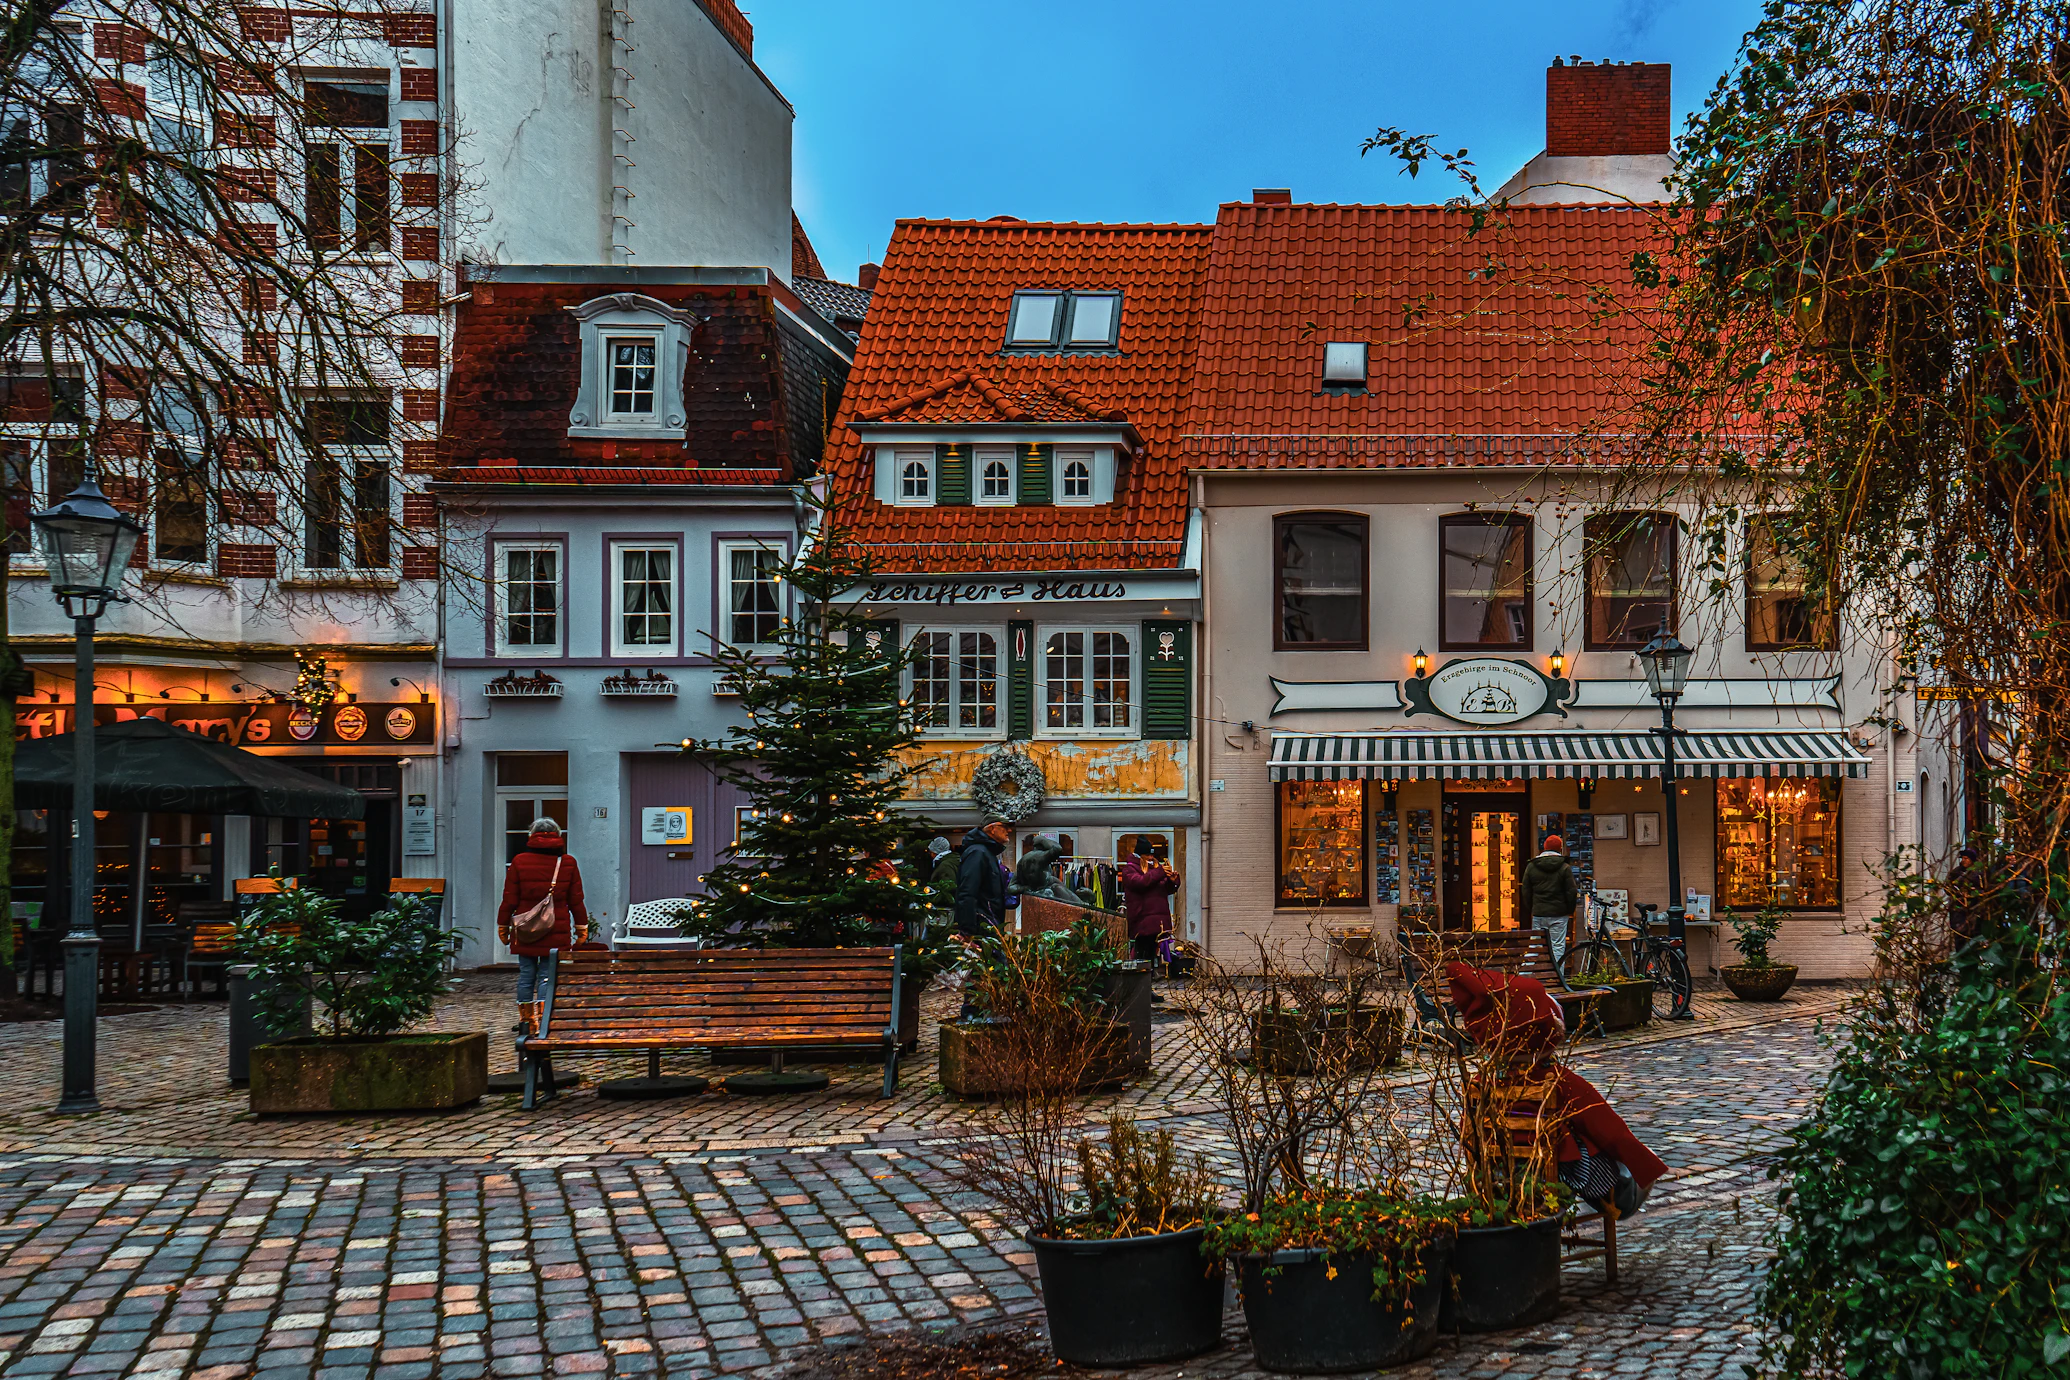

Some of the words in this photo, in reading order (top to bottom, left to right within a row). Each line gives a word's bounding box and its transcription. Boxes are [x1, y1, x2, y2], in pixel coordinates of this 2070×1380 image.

[866, 582, 997, 606] Schiffer
[1031, 580, 1126, 600] Haus
[1441, 664, 1486, 684] Erzgebirge
[1489, 664, 1500, 672] im
[1502, 666, 1538, 686] Schnoor
[1497, 698, 1512, 712] B
[415, 809, 426, 817] 17
